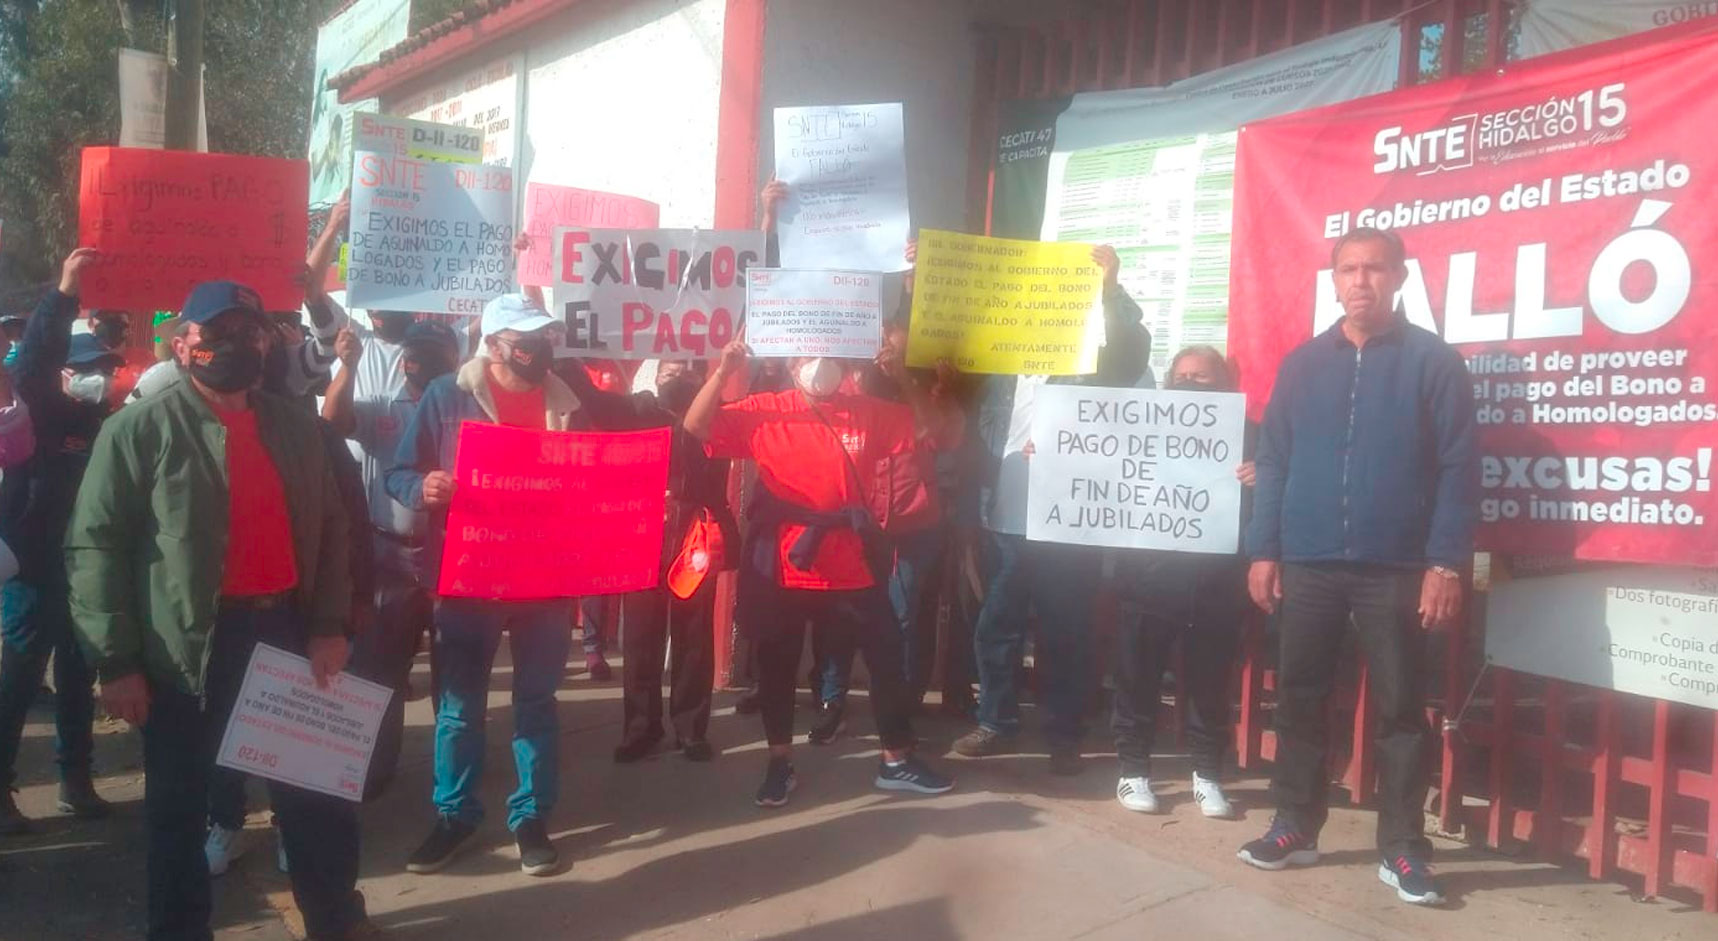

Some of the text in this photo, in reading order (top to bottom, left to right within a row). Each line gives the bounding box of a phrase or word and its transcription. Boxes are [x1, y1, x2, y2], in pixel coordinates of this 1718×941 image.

[361, 116, 406, 140] SNTE
[1373, 82, 1627, 173] SNTE SECCIÓN 15
[1478, 115, 1578, 150] HIDALGO
[359, 153, 426, 191] SNTE
[534, 187, 640, 229] EXIGIMOS
[1324, 159, 1691, 239] El Gobierno del Estado
[368, 211, 513, 242] EXIGIMOS EL PAGO
[352, 231, 374, 249] DE
[458, 241, 470, 255] A
[351, 248, 506, 275] LOGADOS Y EL PAGO
[561, 231, 759, 292] EXIGIMOS
[348, 268, 370, 283] DE
[373, 270, 411, 288] BONO
[414, 274, 425, 289] A
[564, 301, 735, 356] EL PAGO
[1543, 350, 1575, 371] de
[1580, 349, 1688, 374] proveer
[1495, 380, 1557, 402] pago
[1563, 375, 1603, 397] del
[1611, 374, 1683, 396] Bono
[1689, 376, 1706, 394] a
[1077, 399, 1218, 428] EXIGIMOS
[1512, 407, 1526, 424] a
[1532, 400, 1718, 427] Homologados.
[1057, 429, 1229, 462] PAGO DE BONO
[1122, 458, 1158, 481] DE
[1481, 447, 1713, 491] excusas!
[1071, 478, 1210, 512] FIN DE AÑO
[1529, 495, 1704, 526] inmediato.
[1045, 503, 1203, 540] A JUBILADOS
[1615, 585, 1645, 602] Dos
[1608, 643, 1714, 674] Comprobante
[1660, 632, 1704, 654] Copia
